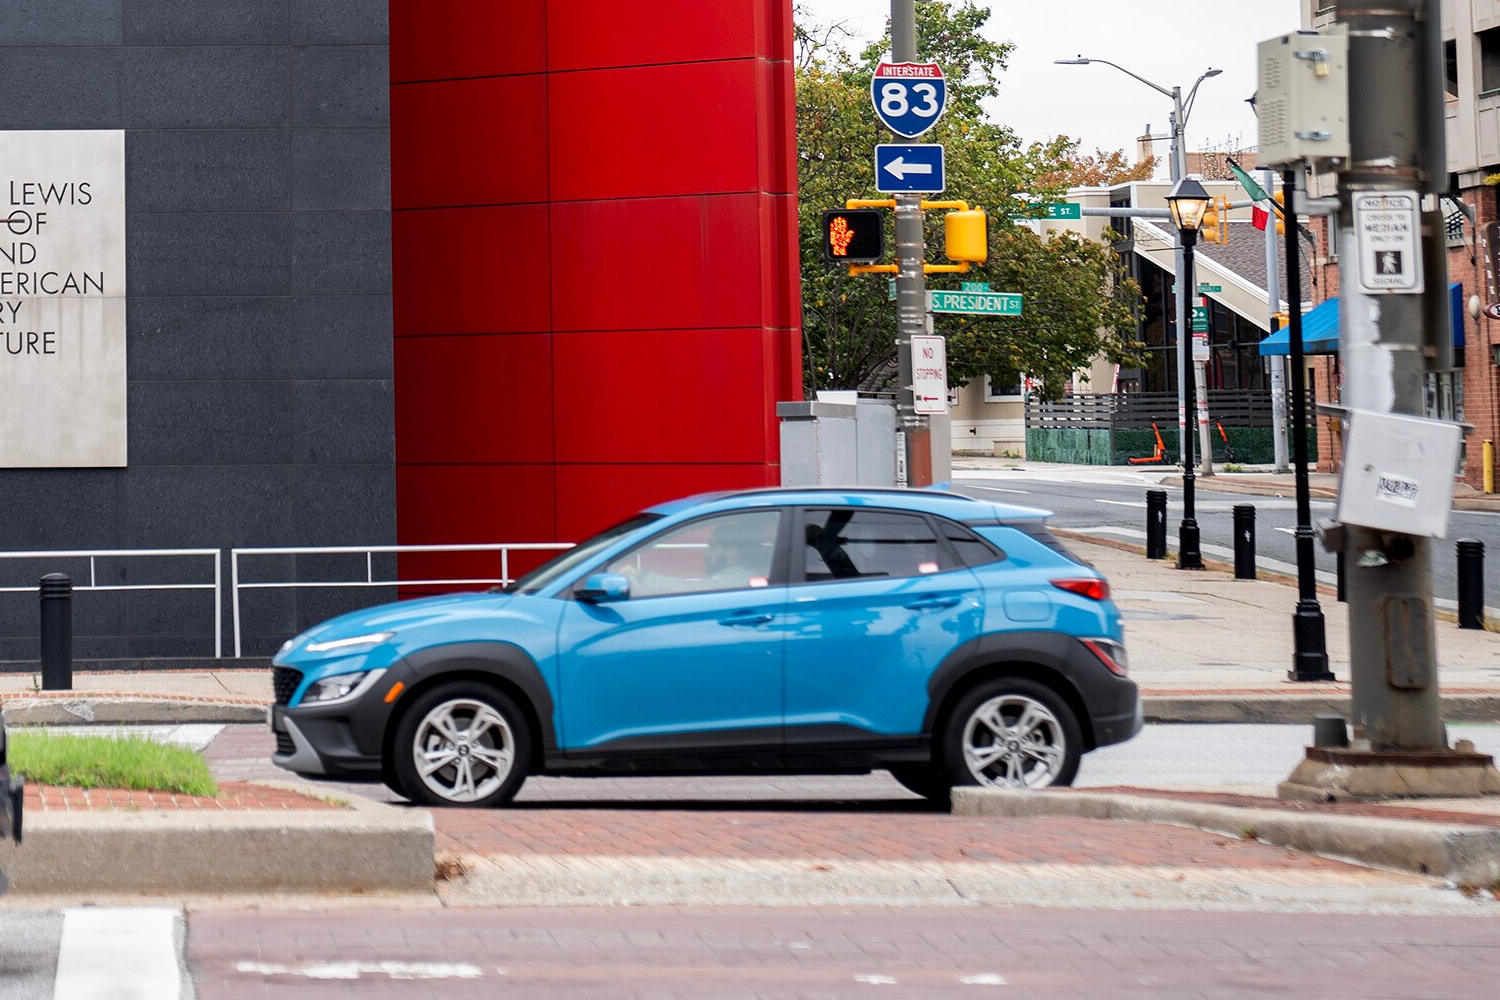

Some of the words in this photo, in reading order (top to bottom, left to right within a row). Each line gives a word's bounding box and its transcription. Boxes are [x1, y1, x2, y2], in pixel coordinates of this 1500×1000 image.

[882, 66, 935, 77] INTERSTATE
[880, 82, 939, 118] 83
[10, 180, 92, 206] LEWIS
[1060, 207, 1072, 215] ST.
[7, 210, 47, 236] OF
[1363, 222, 1410, 233] MEDIAN
[1369, 234, 1389, 242] ONLY
[1372, 277, 1405, 286] SIGNAL
[932, 294, 942, 308] S.
[943, 295, 1008, 311] PRESIDENT
[922, 346, 934, 359] NO
[916, 368, 943, 380] STOPPING
